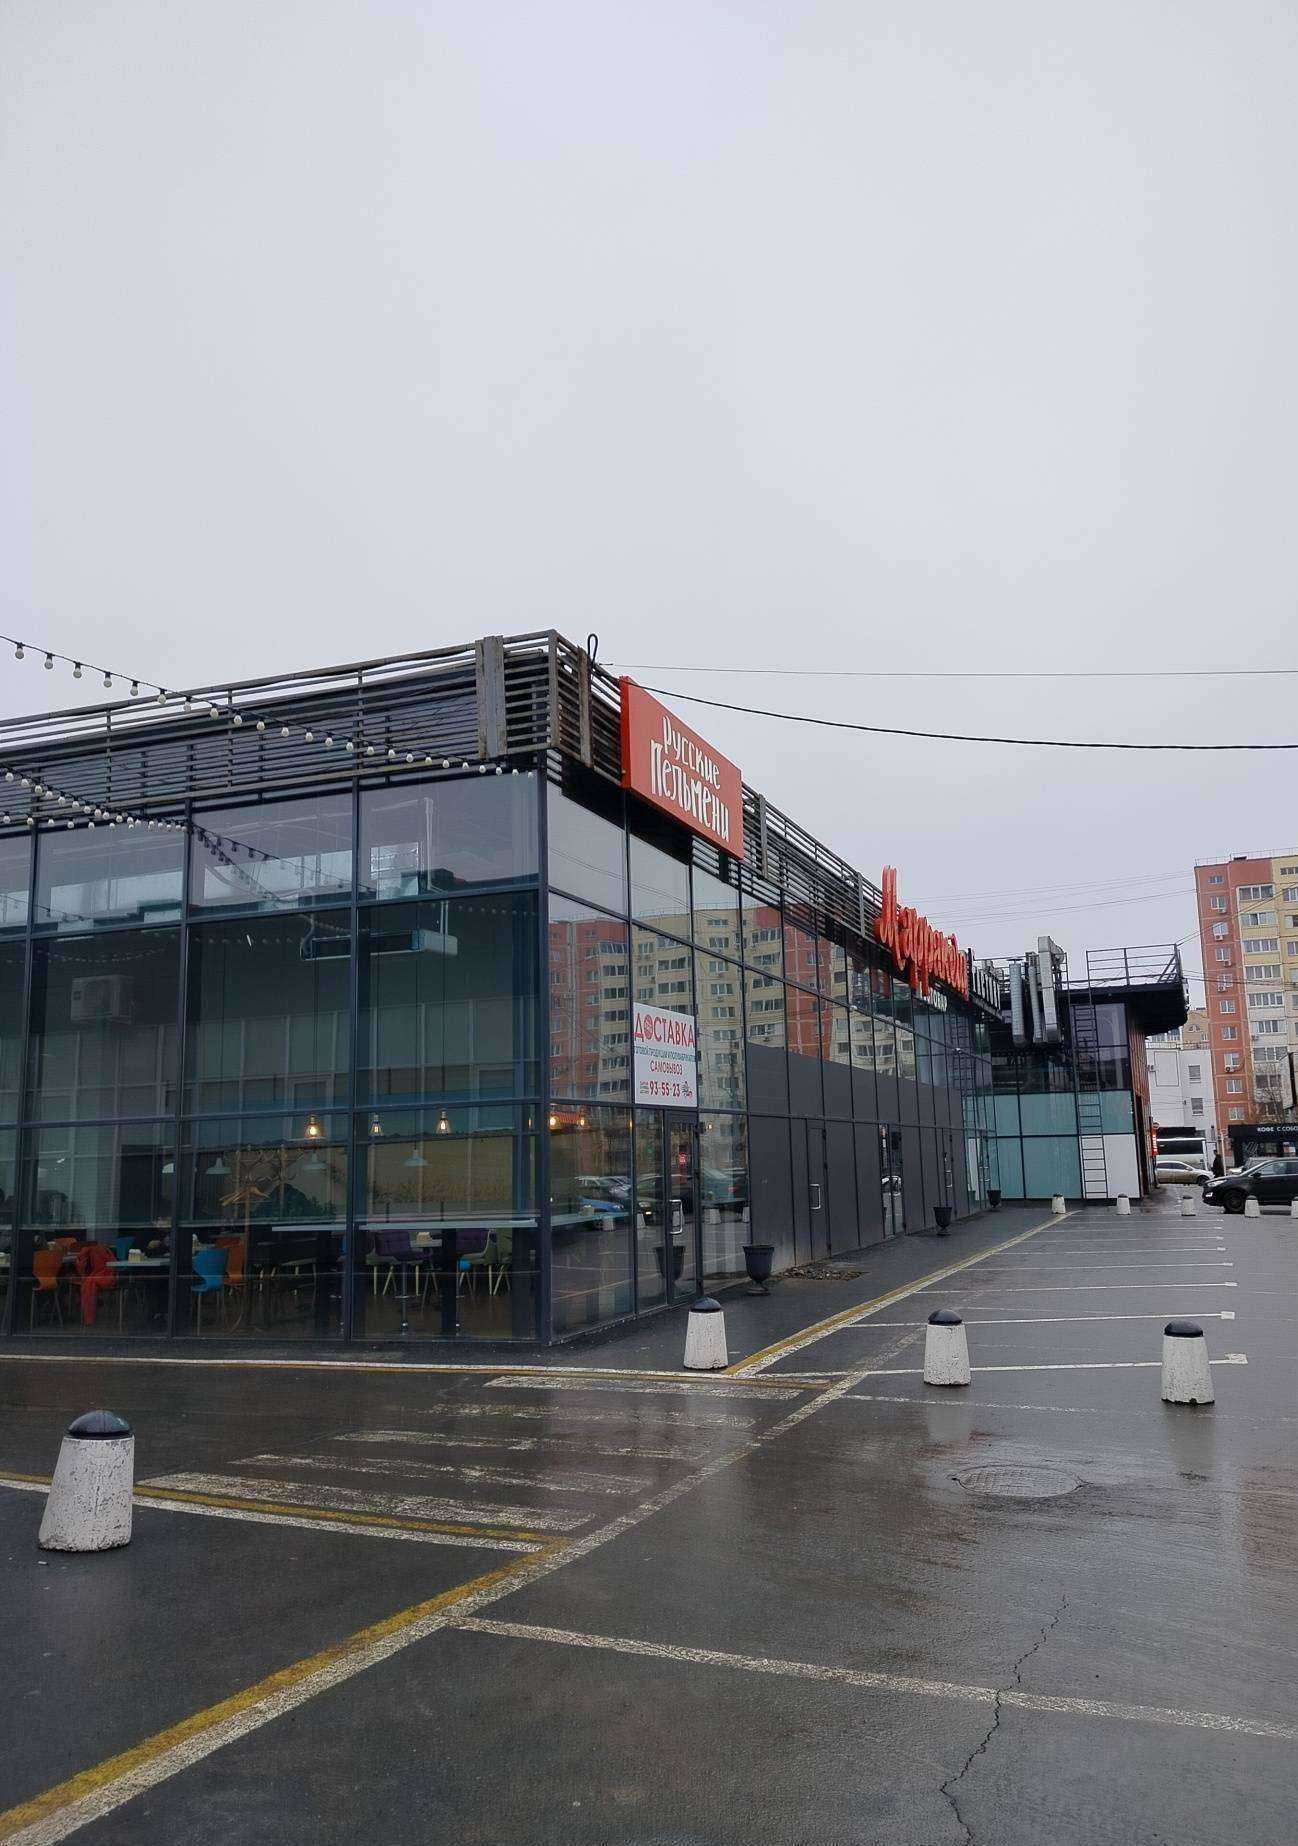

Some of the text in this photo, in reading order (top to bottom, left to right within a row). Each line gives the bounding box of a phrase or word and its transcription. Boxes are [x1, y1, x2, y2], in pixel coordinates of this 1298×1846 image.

[662, 716, 721, 790] Русские
[650, 738, 730, 843] Пельмени
[634, 1012, 695, 1048] ДОСТАВКА
